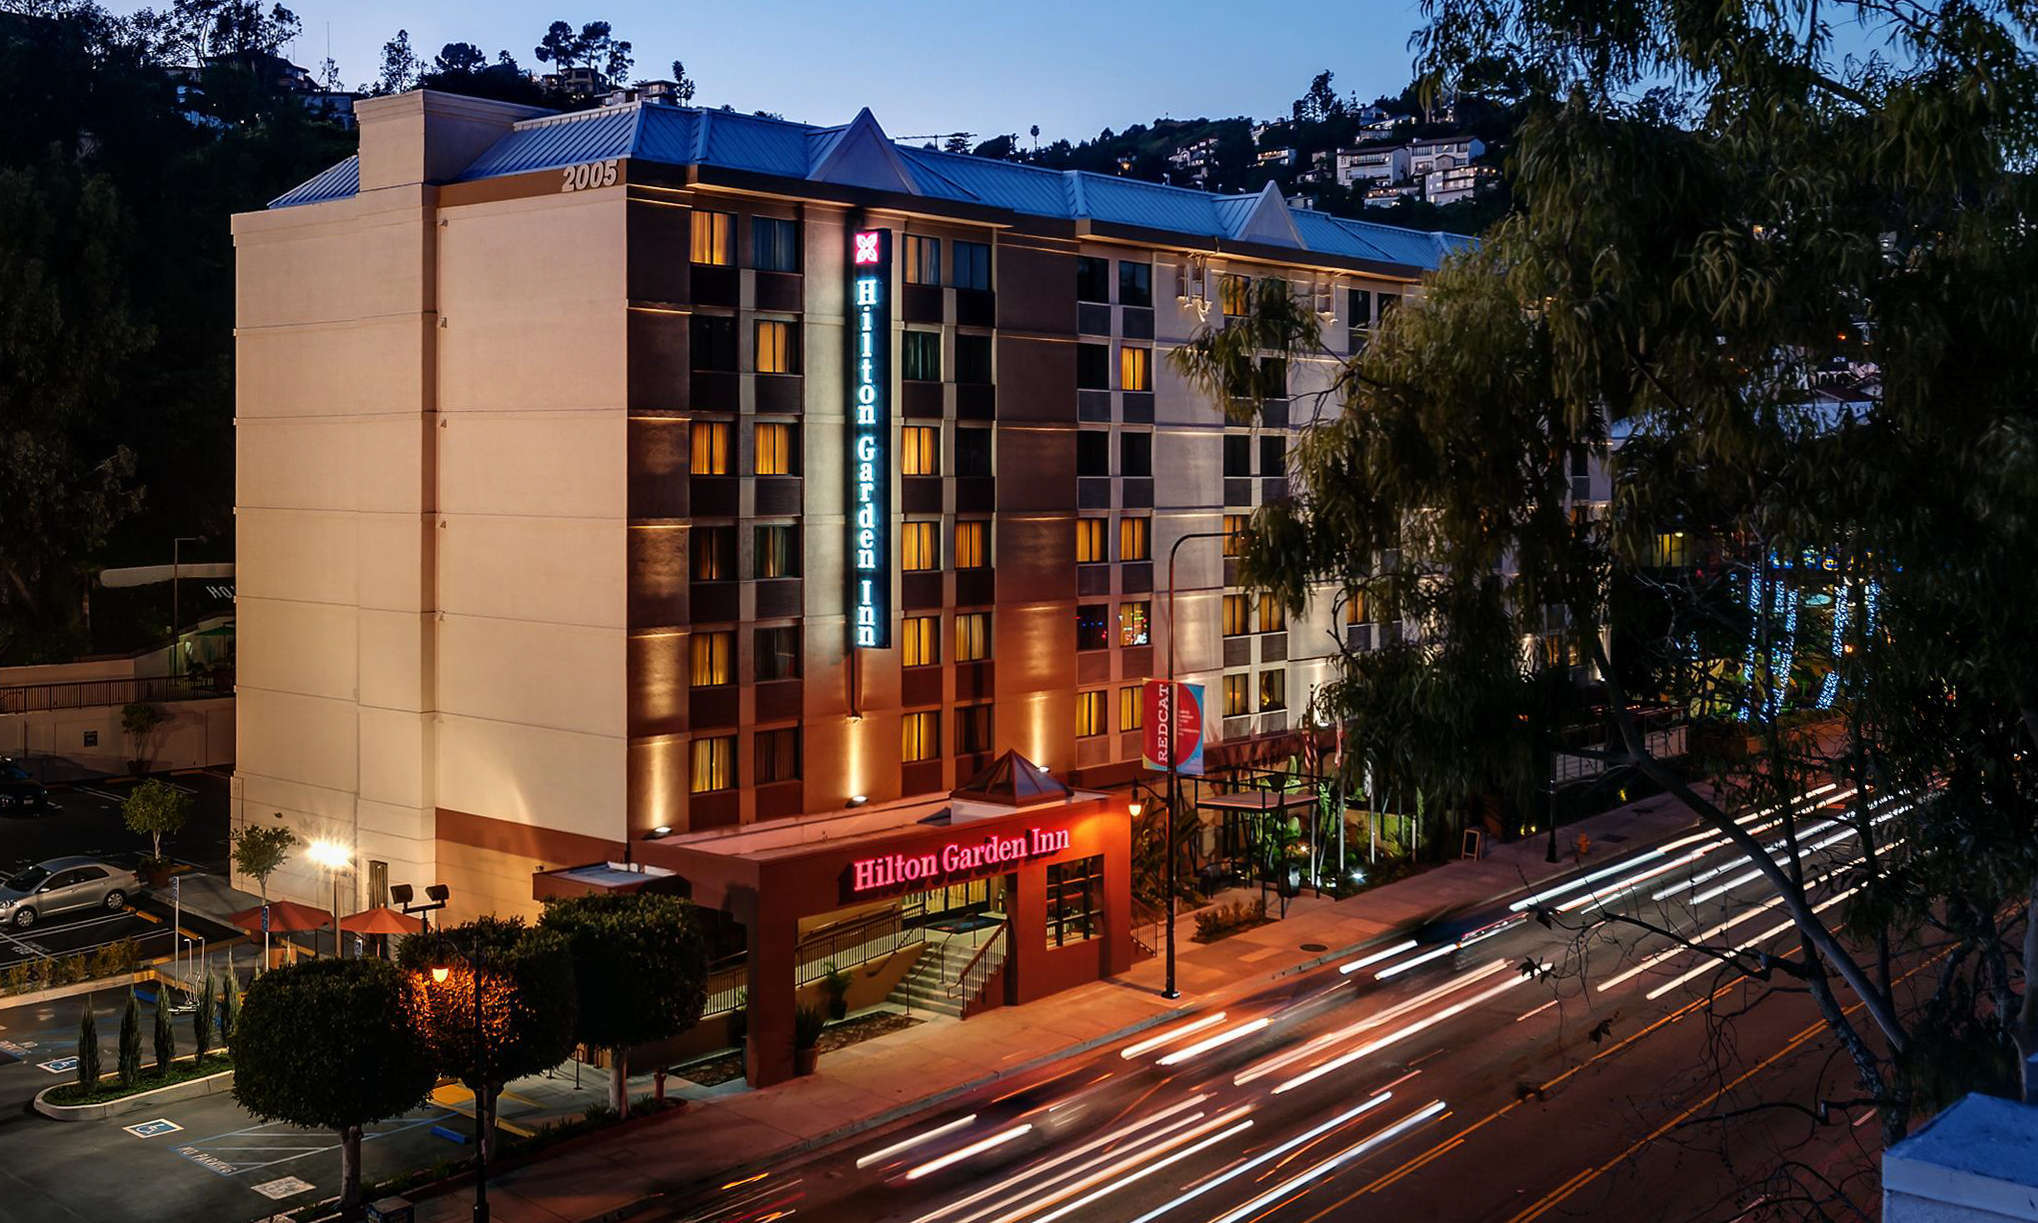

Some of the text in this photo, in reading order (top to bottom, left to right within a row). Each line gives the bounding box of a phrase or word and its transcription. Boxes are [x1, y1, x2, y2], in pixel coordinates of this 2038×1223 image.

[562, 159, 618, 193] 2005
[857, 279, 876, 646] Hilton Garden Inn
[206, 585, 235, 599] HO
[1158, 683, 1169, 763] REDCAT
[854, 828, 1070, 891] Hilton Garden Inn
